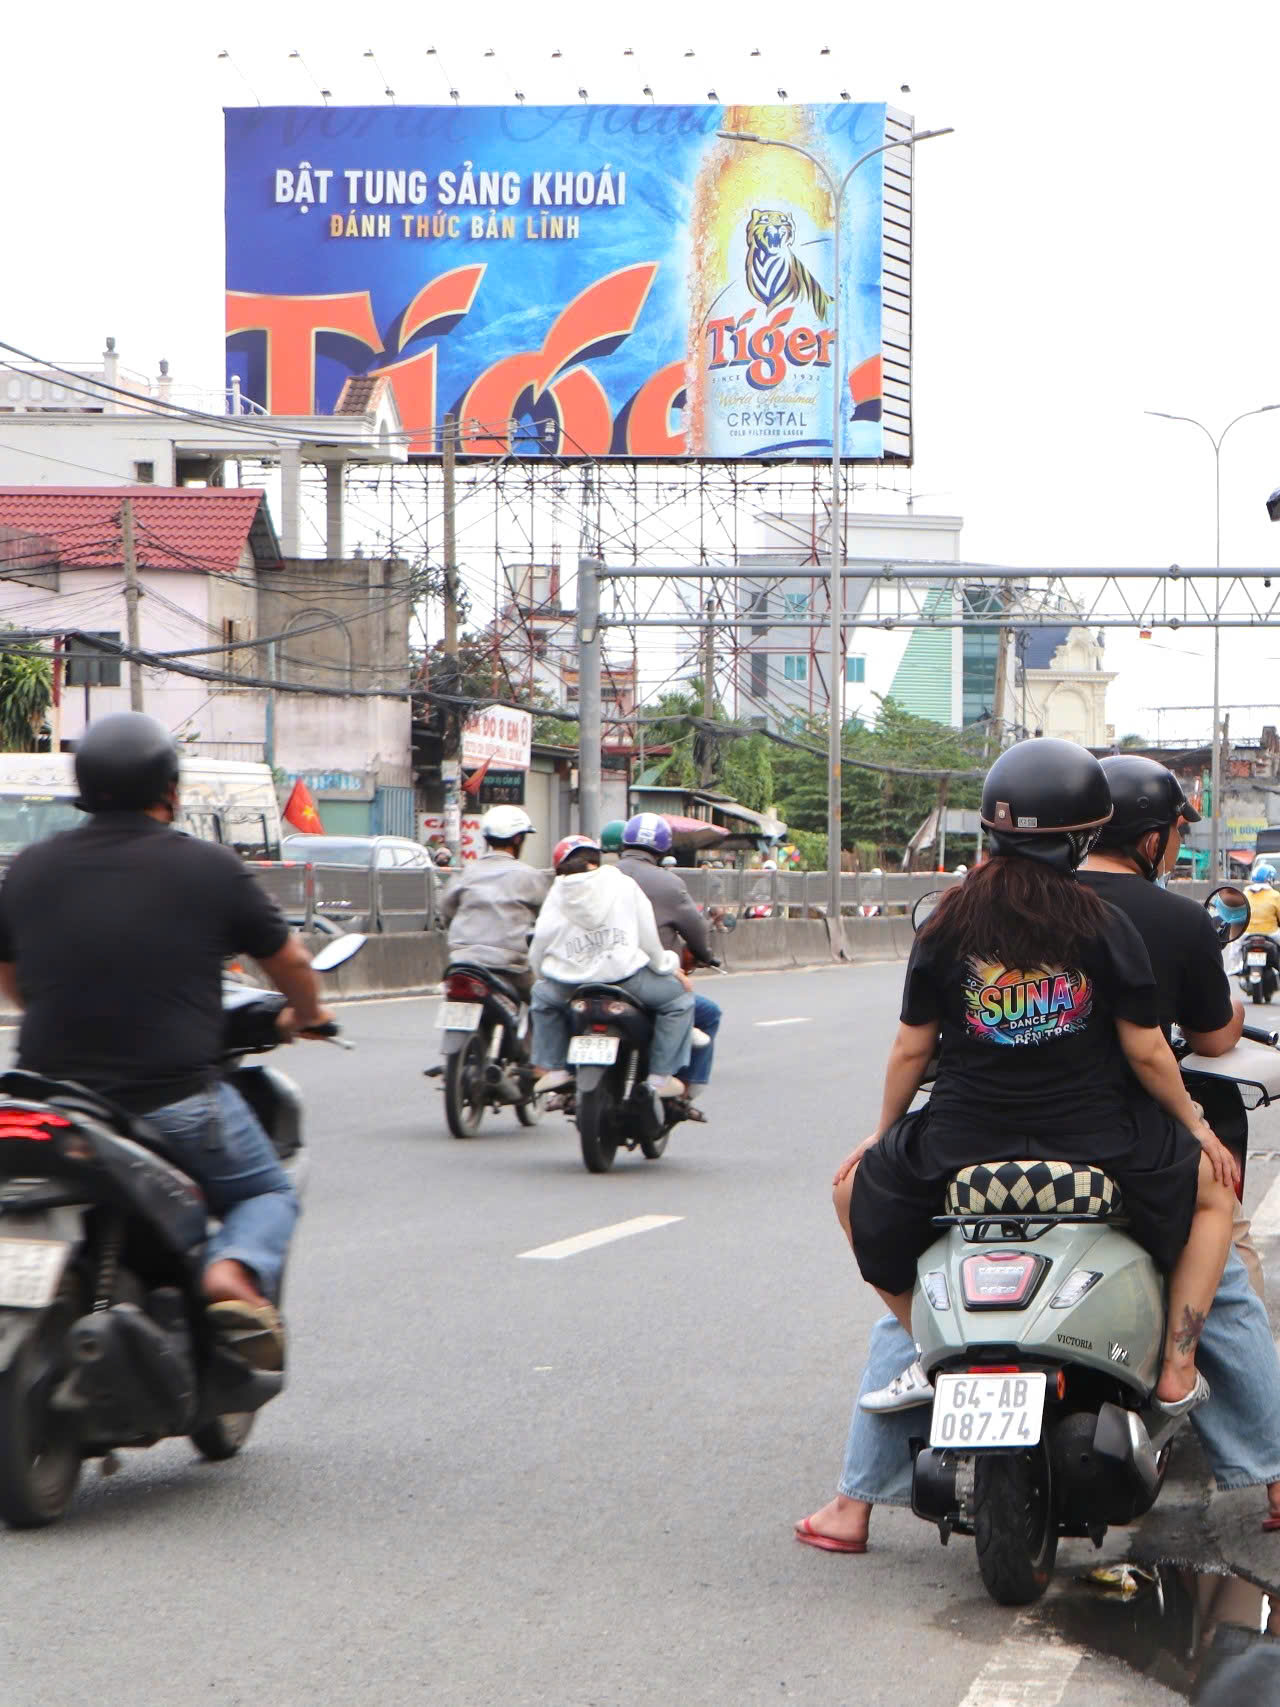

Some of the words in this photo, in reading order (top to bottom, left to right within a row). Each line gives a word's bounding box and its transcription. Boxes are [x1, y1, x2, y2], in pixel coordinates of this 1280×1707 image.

[274, 163, 333, 214] BẬT
[344, 169, 427, 206] TUNG
[438, 161, 521, 206] SẢNG
[532, 167, 626, 206] KHOÁI
[330, 212, 391, 239] ĐÁNH
[401, 209, 461, 239] THỨC
[471, 210, 517, 239] BẢN
[526, 211, 580, 239] LĨNH
[706, 306, 836, 391] Tiger
[712, 374, 741, 384] SINCE
[727, 411, 808, 427] CRYSTAL
[730, 428, 746, 437] COLD
[749, 428, 781, 437] FILTERED
[783, 428, 804, 437] LAGER
[979, 972, 1076, 1028] SUNA
[1010, 1016, 1047, 1030] DANCE
[1057, 1334, 1093, 1350] VICTORIA
[952, 1379, 1028, 1409] 64-AB
[941, 1412, 1031, 1441] 087.74
